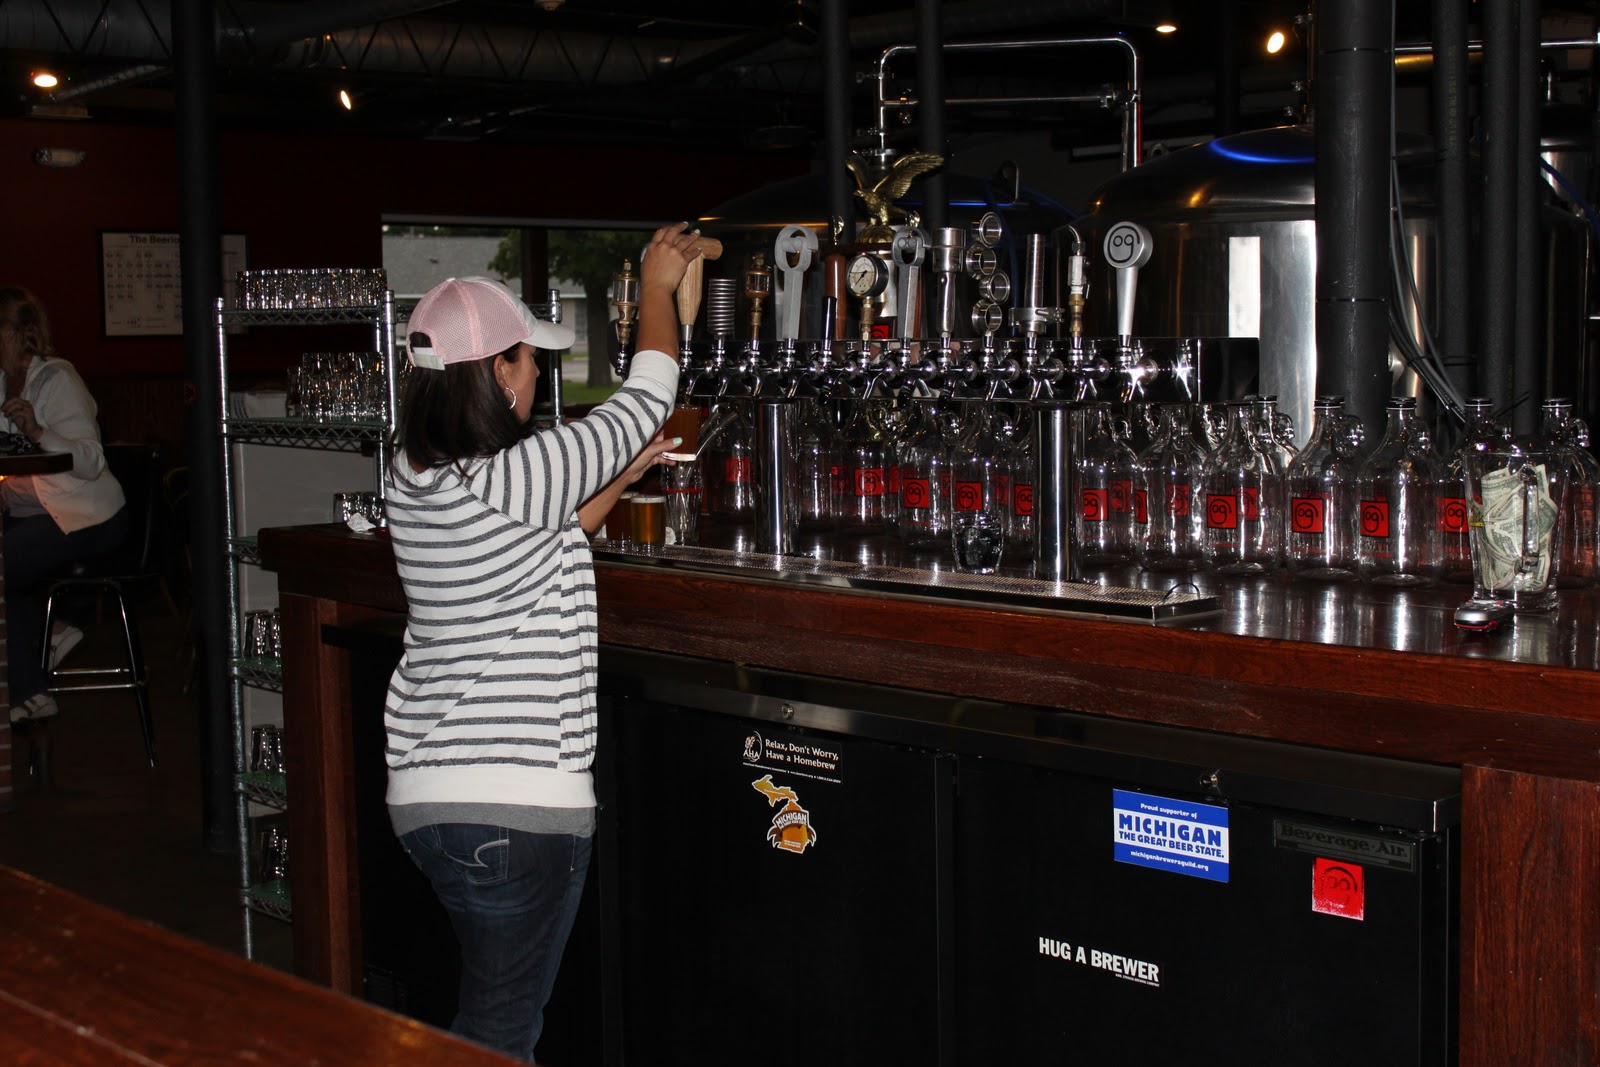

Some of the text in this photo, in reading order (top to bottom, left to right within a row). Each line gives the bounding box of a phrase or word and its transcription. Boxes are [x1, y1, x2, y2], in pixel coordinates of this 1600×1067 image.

[130, 235, 148, 244] The
[743, 749, 760, 759] AHA
[765, 739, 839, 761] Relax, Don't Worry,
[766, 750, 784, 761] Have
[793, 755, 836, 770] Homebrew
[776, 812, 806, 829] MICHIGAN
[1140, 803, 1159, 812] Proud
[1160, 807, 1190, 818] supporter
[1118, 813, 1222, 847] MICHIGAN
[1119, 831, 1136, 842] THE
[1137, 835, 1167, 847] GREAT
[1168, 840, 1194, 853] BEER
[1130, 850, 1209, 872] michiganbrewersguild.org
[1039, 936, 1071, 961] HUG
[1075, 946, 1087, 965] A
[1091, 949, 1159, 982] BREWER
